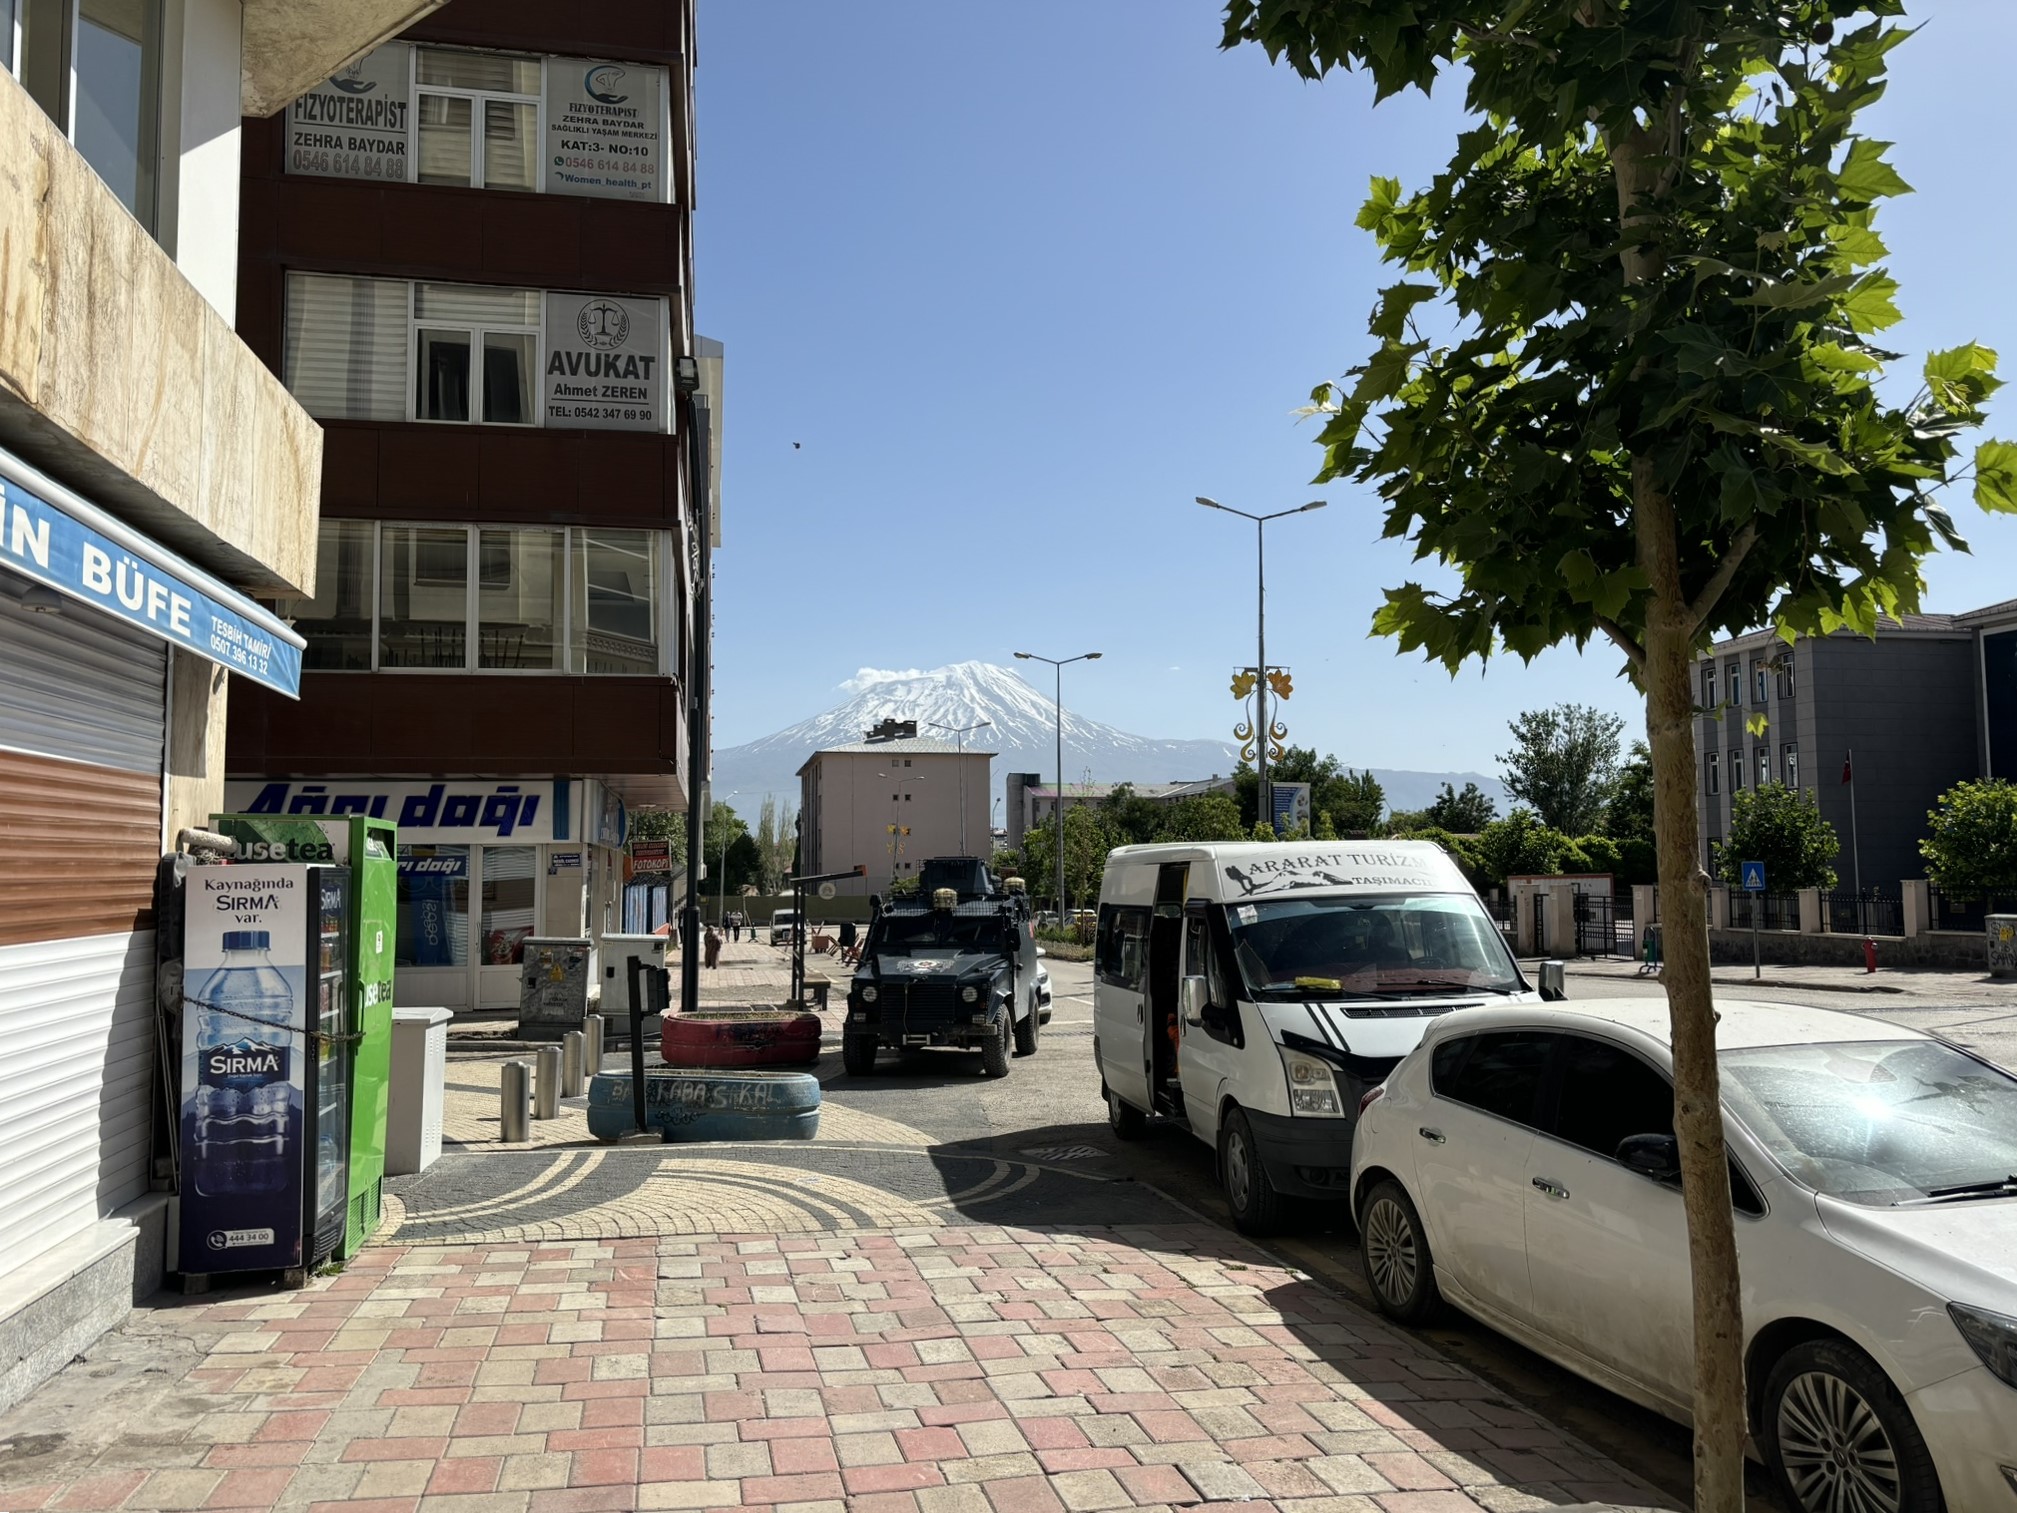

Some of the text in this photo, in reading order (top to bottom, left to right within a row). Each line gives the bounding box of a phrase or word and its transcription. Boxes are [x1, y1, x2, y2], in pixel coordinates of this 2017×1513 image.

[562, 115, 645, 129] ZEHRA BAYDAR
[552, 124, 657, 140] SAĞLIKLI YAŞAM MERKEZİ
[294, 132, 405, 155] ZEHRA BAYDAR
[608, 144, 648, 156] NO:10
[293, 150, 404, 178] 0546 614 84 88
[565, 157, 655, 174] 0546 614 84 88
[548, 351, 655, 380] AVUKAT
[554, 383, 647, 399] Ahmet ZEREN
[549, 406, 651, 421] TEL: 0542 347 69 90
[83, 541, 192, 638] BÜFE
[211, 616, 272, 660] TESBİH TAMİRİ
[210, 634, 268, 675] 0507 396 13 32
[397, 784, 541, 837] dağı
[236, 838, 333, 861] usetea
[397, 861, 414, 872] rı
[415, 858, 461, 874] dağı
[1249, 854, 1342, 875] ARARAT
[204, 877, 294, 893] Kaynağında
[216, 894, 279, 910] SIRMA
[235, 914, 262, 923] var.
[365, 980, 391, 1008] usetea
[210, 1054, 279, 1074] SIRMA
[247, 1233, 256, 1241] 34
